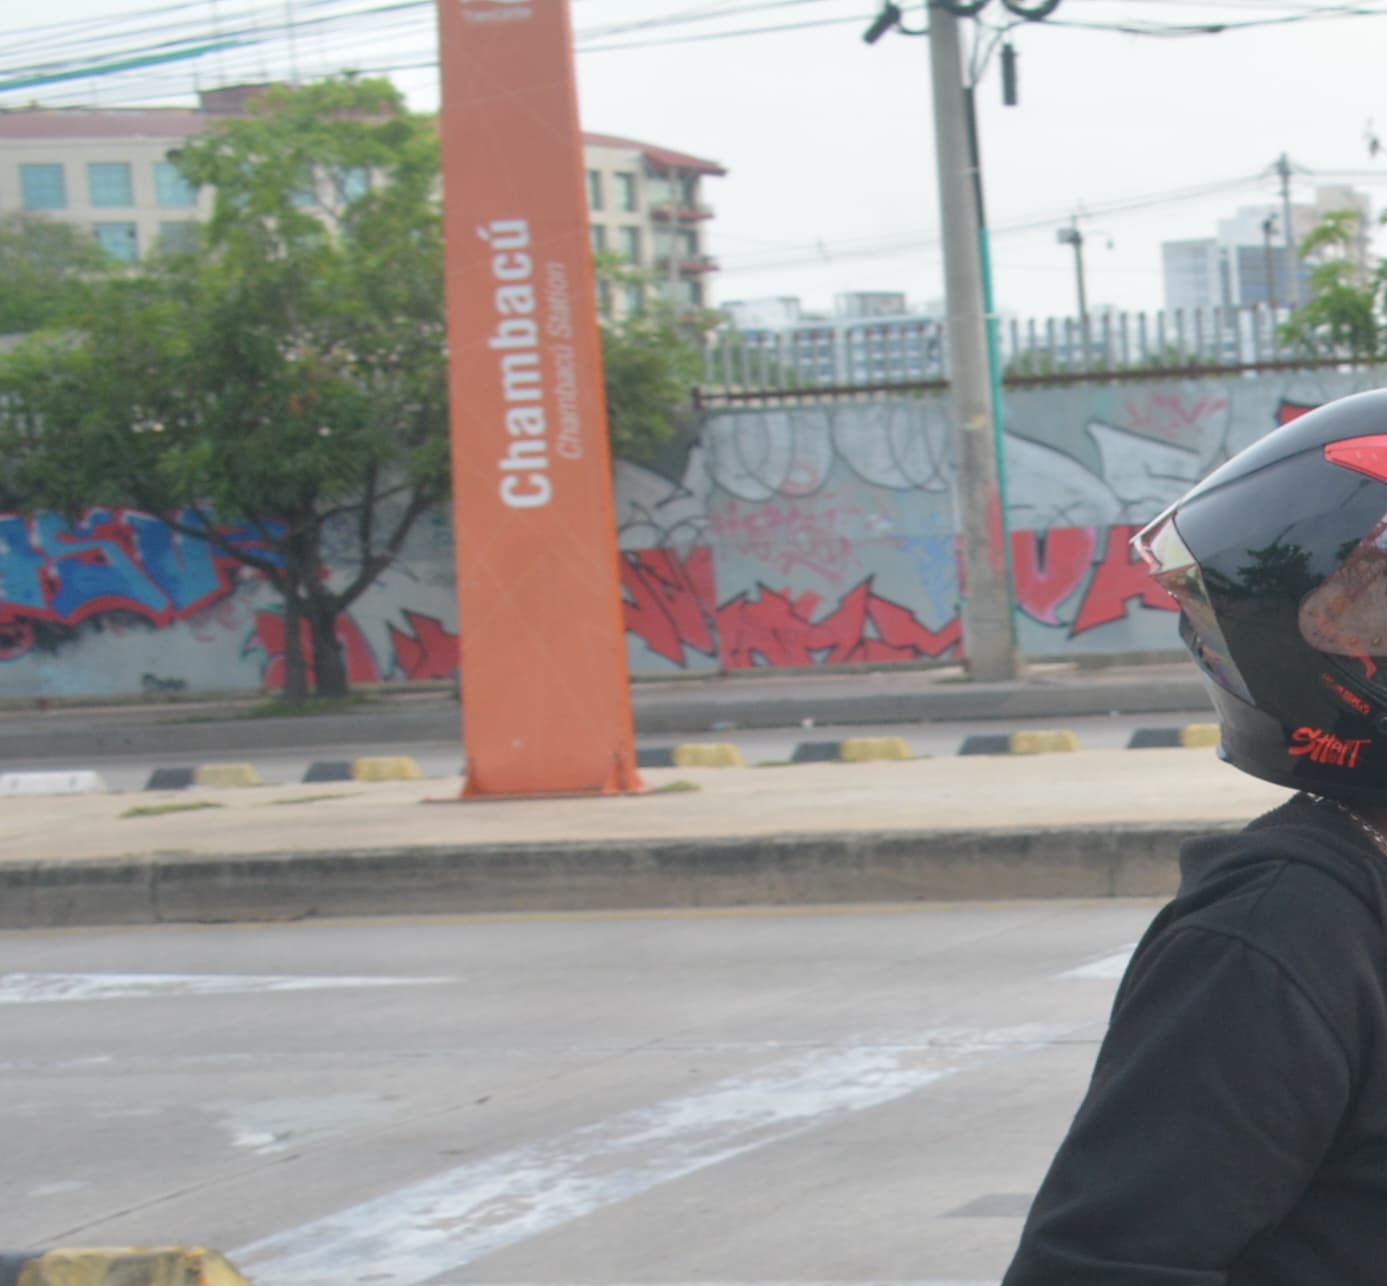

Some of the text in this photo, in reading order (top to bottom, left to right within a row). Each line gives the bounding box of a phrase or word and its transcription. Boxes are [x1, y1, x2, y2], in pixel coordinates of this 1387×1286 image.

[477, 218, 553, 509] Chambacú
[545, 261, 582, 460] Chambacú Station
